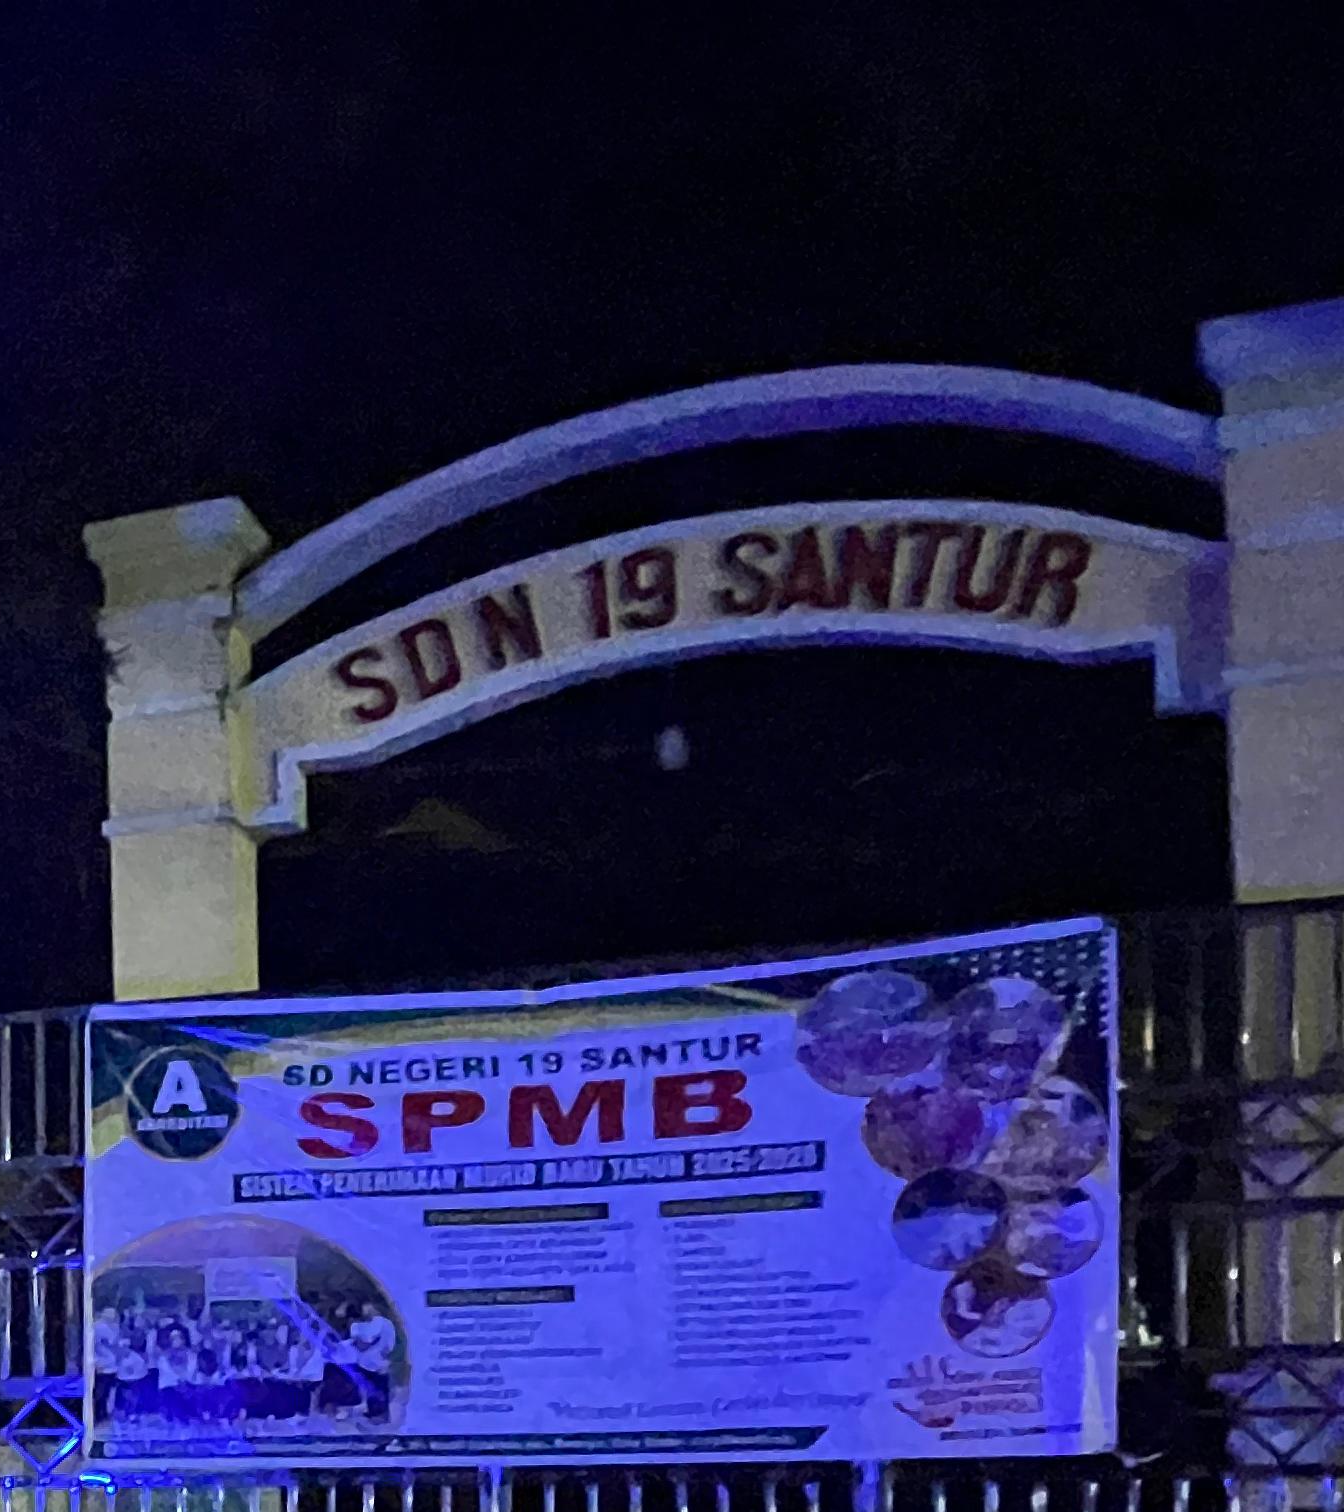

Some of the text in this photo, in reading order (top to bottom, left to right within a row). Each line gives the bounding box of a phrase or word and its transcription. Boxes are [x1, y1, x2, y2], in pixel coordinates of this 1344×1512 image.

[574, 547, 679, 640] 19
[716, 522, 1092, 629] SANTUR
[152, 1060, 208, 1114] A
[282, 1032, 764, 1086] SD NEGERI 19 SANTUR
[296, 1069, 753, 1159] SPMB
